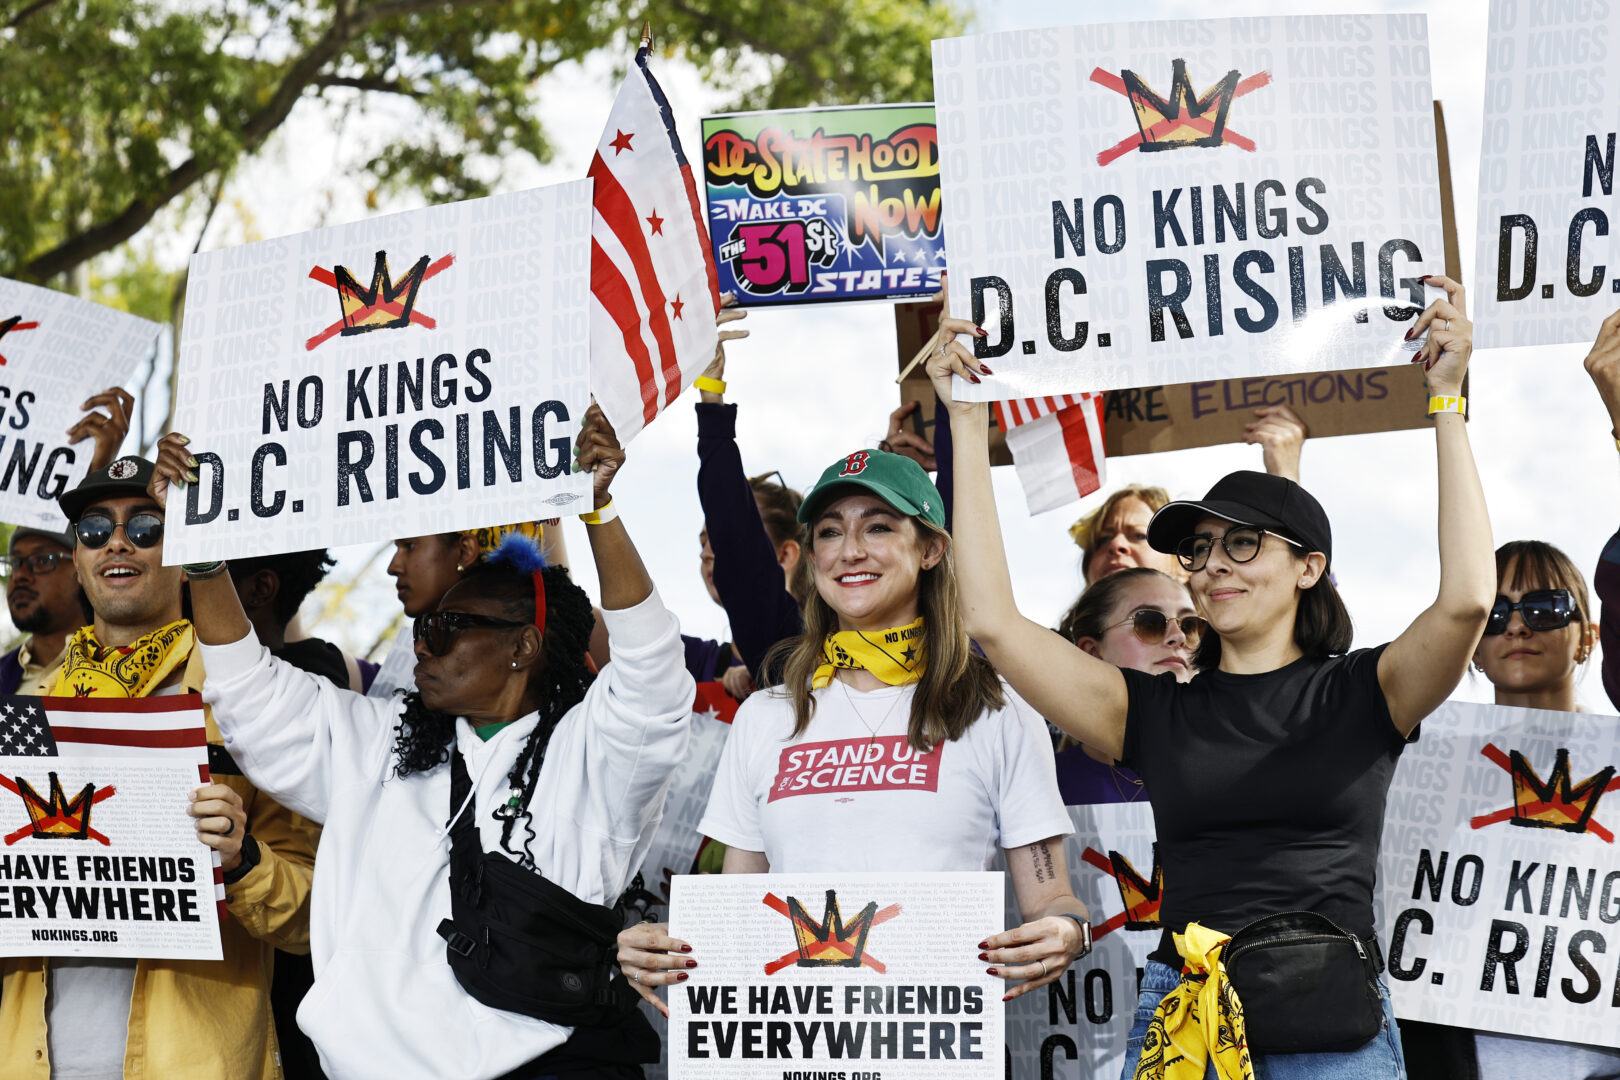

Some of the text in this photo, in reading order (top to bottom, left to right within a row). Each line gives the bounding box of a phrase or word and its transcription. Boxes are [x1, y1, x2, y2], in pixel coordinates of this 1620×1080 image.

[1528, 24, 1608, 69] KINGS
[975, 44, 1430, 101] KINGS KINGS NO
[1525, 66, 1606, 110] KINGS
[977, 78, 1431, 137] KINGS NO KINGS NO
[979, 114, 1434, 177] KINGS KINGS NO
[1396, 150, 1437, 184] NO
[1520, 150, 1583, 190] KING
[728, 198, 827, 221] MAKE DC
[1051, 177, 1329, 259] NO KINGS
[1398, 184, 1439, 220] NO
[217, 207, 590, 303] KINGS KINGS NO
[721, 239, 746, 257] THE
[1497, 207, 1620, 302] D.C.
[215, 240, 589, 336] KINGS NO KINGS NO
[970, 238, 1426, 360] D.C. RISING
[1088, 284, 1131, 322] NO
[211, 274, 588, 368] KINGS KINGS NO
[551, 309, 587, 346] NO
[551, 343, 587, 380] NO
[262, 348, 492, 435] NO KINGS
[1104, 370, 1391, 422] ARE ELECTIONS
[185, 399, 571, 526] D.C. RISING
[285, 455, 323, 491] NO
[838, 450, 871, 477] B
[885, 632, 899, 643] NO
[785, 743, 885, 773] STAND
[790, 764, 928, 791] SCIENCE
[1460, 764, 1502, 798] NO
[76, 855, 195, 883] FRIENDS
[1411, 848, 1485, 906] NO
[31, 929, 118, 942] NOKINGS.ORG
[687, 986, 983, 1014] WE HAVE FRIENDS
[1048, 968, 1113, 1025] NO
[688, 1021, 983, 1060] EVERYWHERE
[782, 1071, 881, 1080] NOKINGSORG
